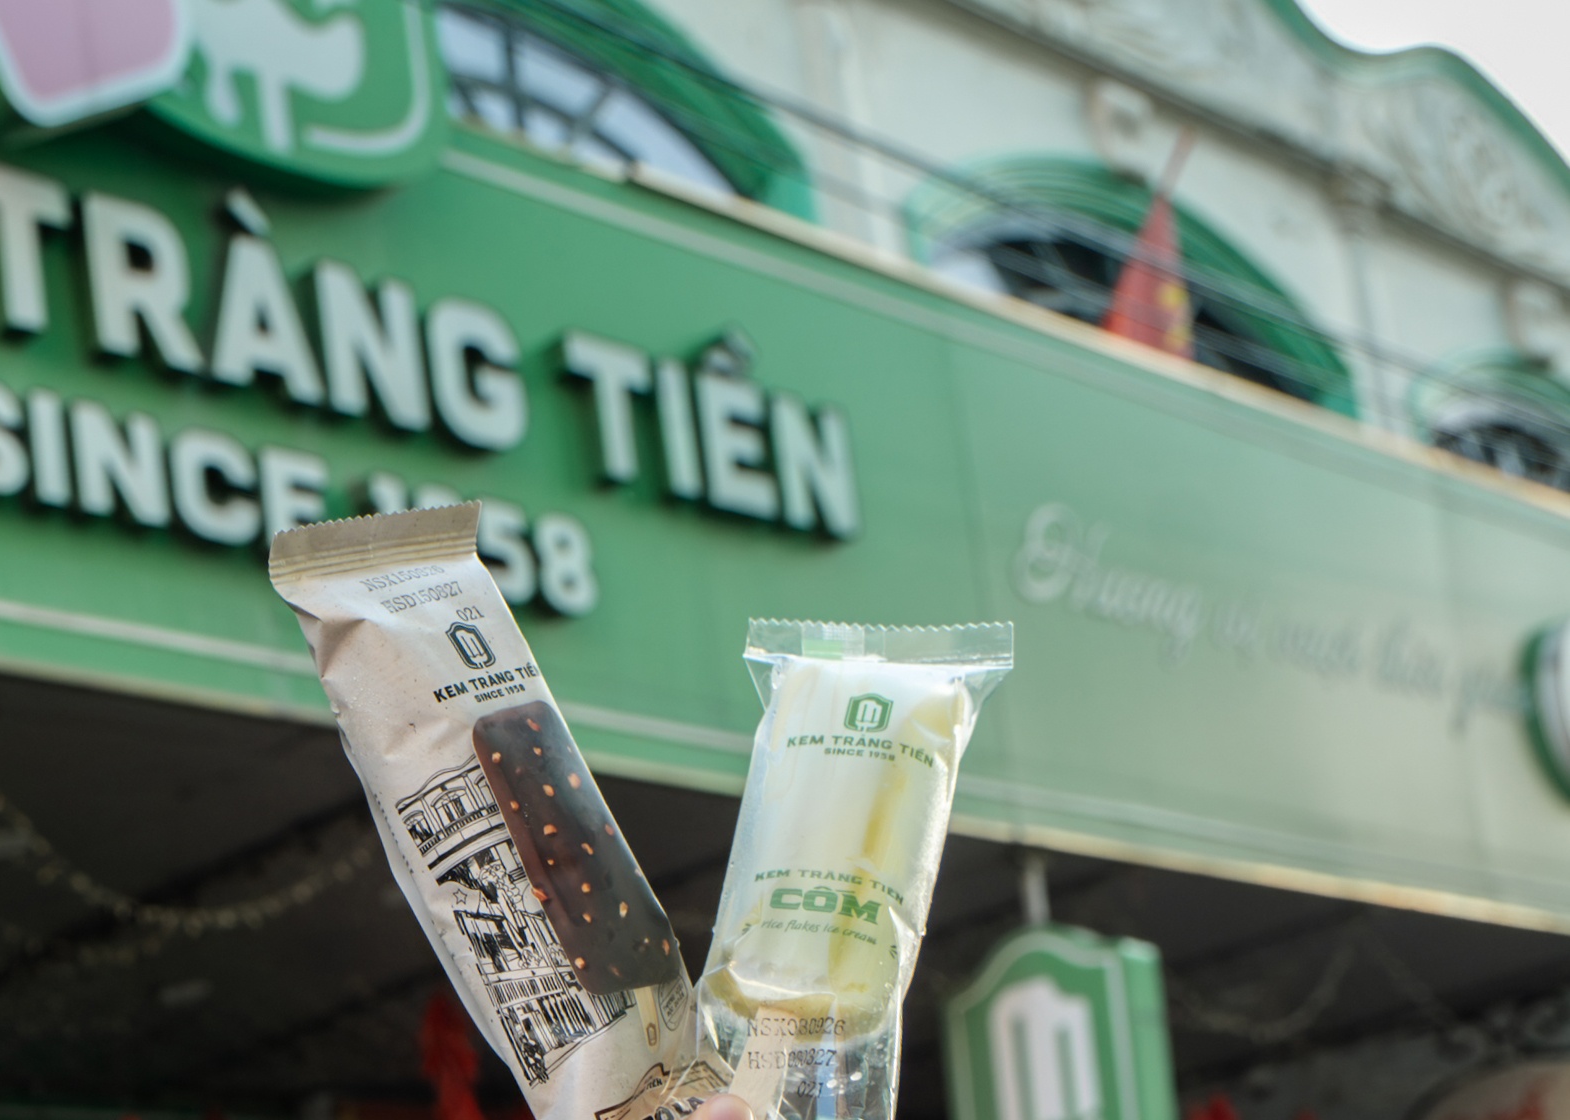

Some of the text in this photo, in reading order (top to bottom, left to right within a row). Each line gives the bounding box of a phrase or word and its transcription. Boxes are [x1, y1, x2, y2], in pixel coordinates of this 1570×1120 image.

[455, 606, 485, 621] 021
[433, 682, 469, 703] KEM
[468, 671, 515, 690] TRÀNG
[474, 689, 505, 703] SINCE
[787, 735, 824, 748] KEM
[824, 747, 864, 757] SINCE
[755, 869, 790, 882] KEM
[761, 918, 784, 930] rice
[784, 919, 821, 933] flakes
[823, 922, 840, 934] ice
